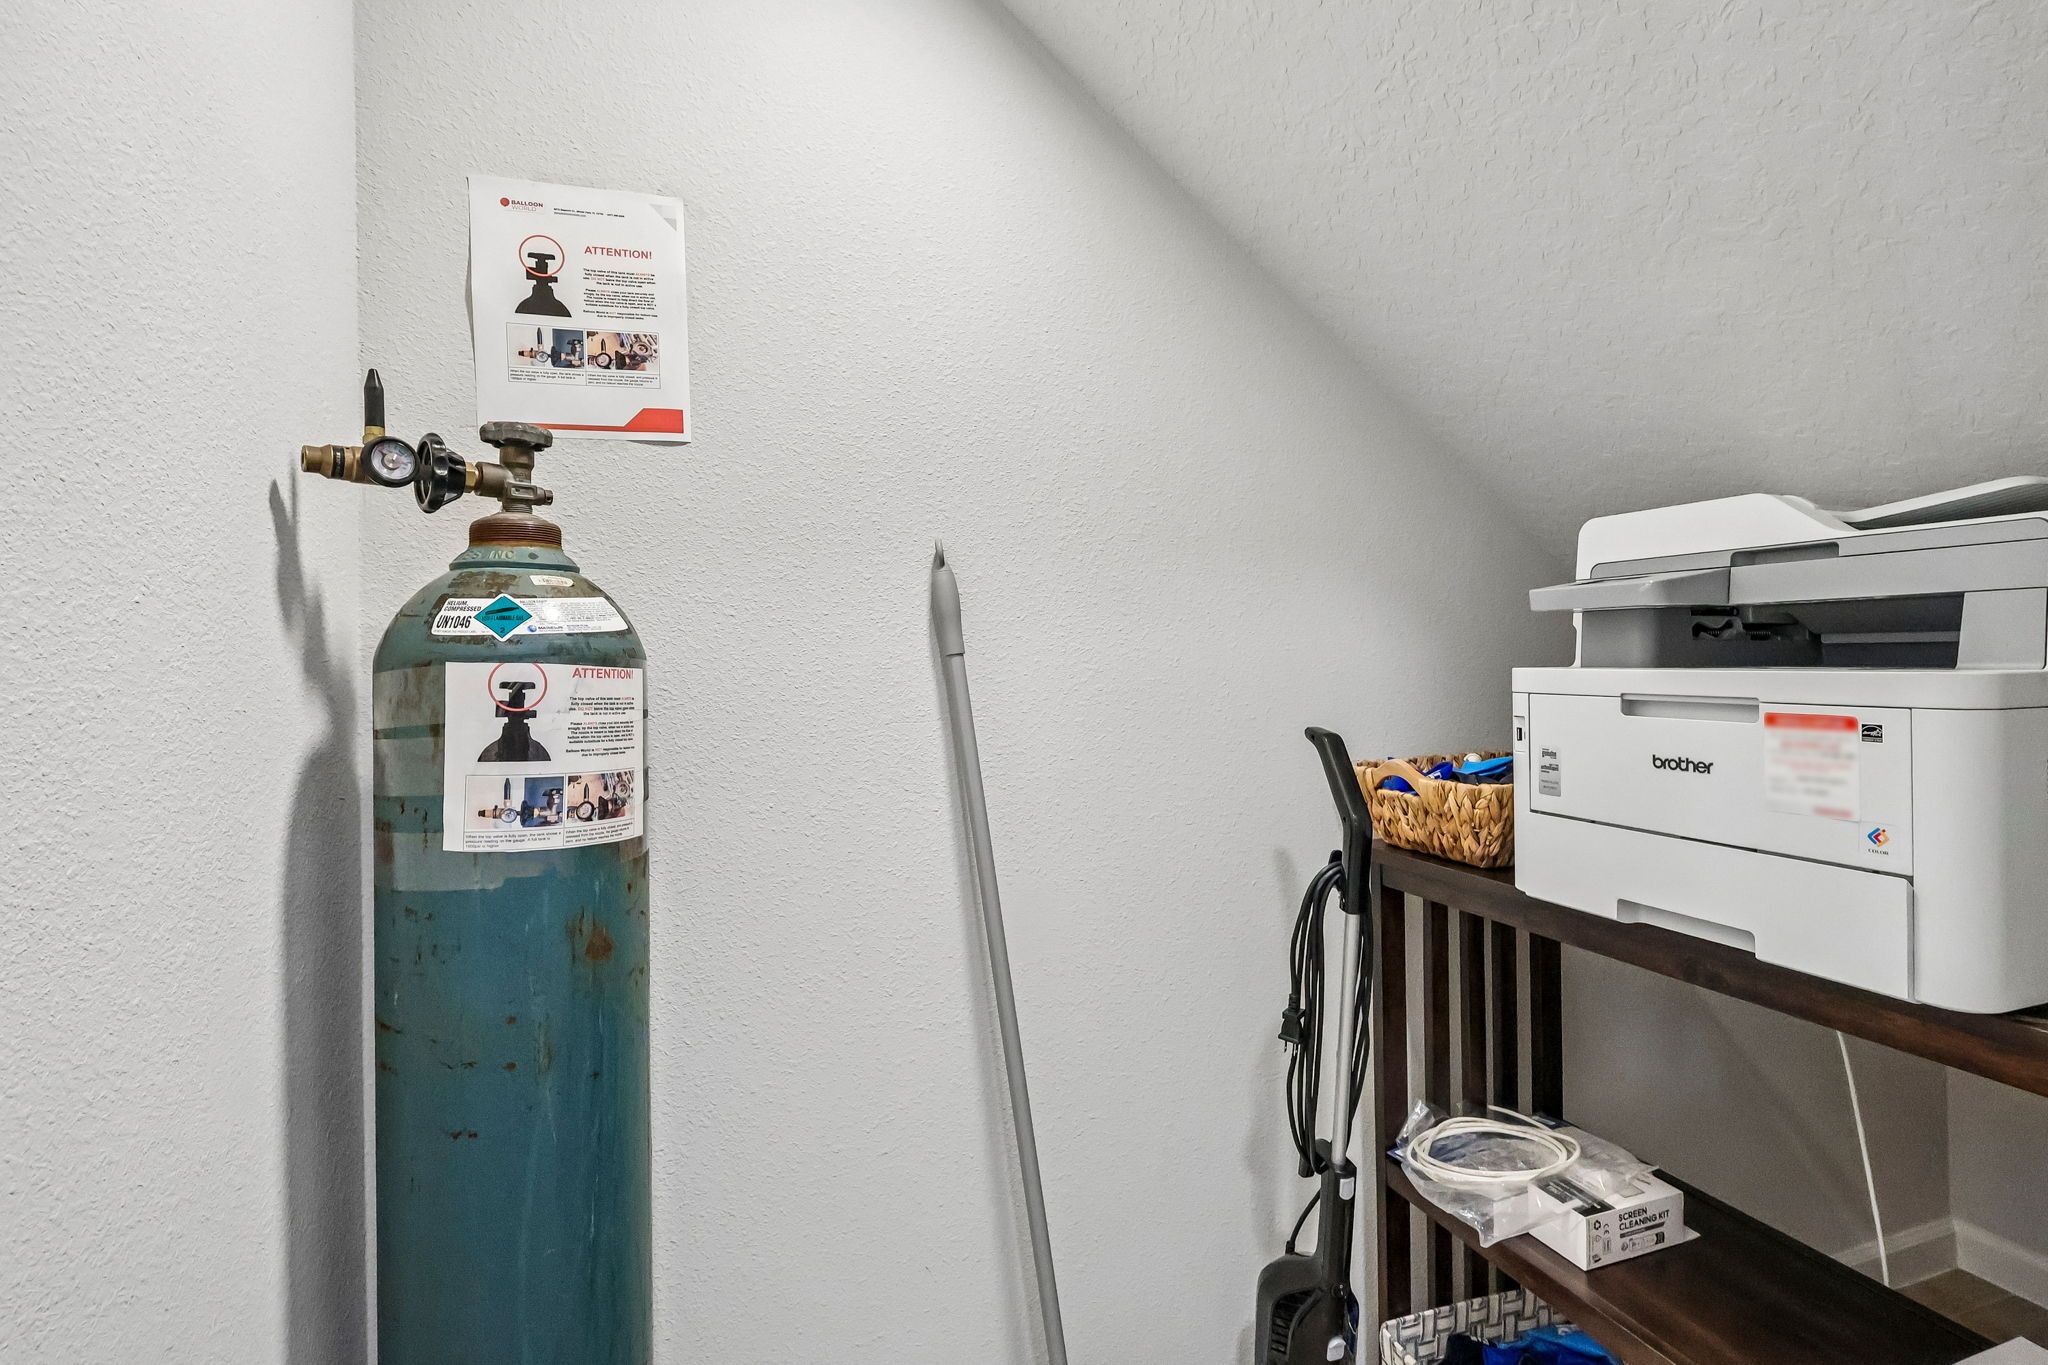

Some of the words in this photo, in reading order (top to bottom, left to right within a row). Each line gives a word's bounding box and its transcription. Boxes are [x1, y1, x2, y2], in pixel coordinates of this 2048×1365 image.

[584, 246, 652, 260] ATTENTION!
[436, 614, 472, 629] UN1046
[500, 626, 506, 634] 2
[572, 667, 634, 679] ATTENTION!
[1652, 754, 1714, 774] brother
[1618, 1207, 1648, 1222] SCREEN
[1619, 1213, 1658, 1230] CLEANING
[1658, 1209, 1670, 1219] KIT
